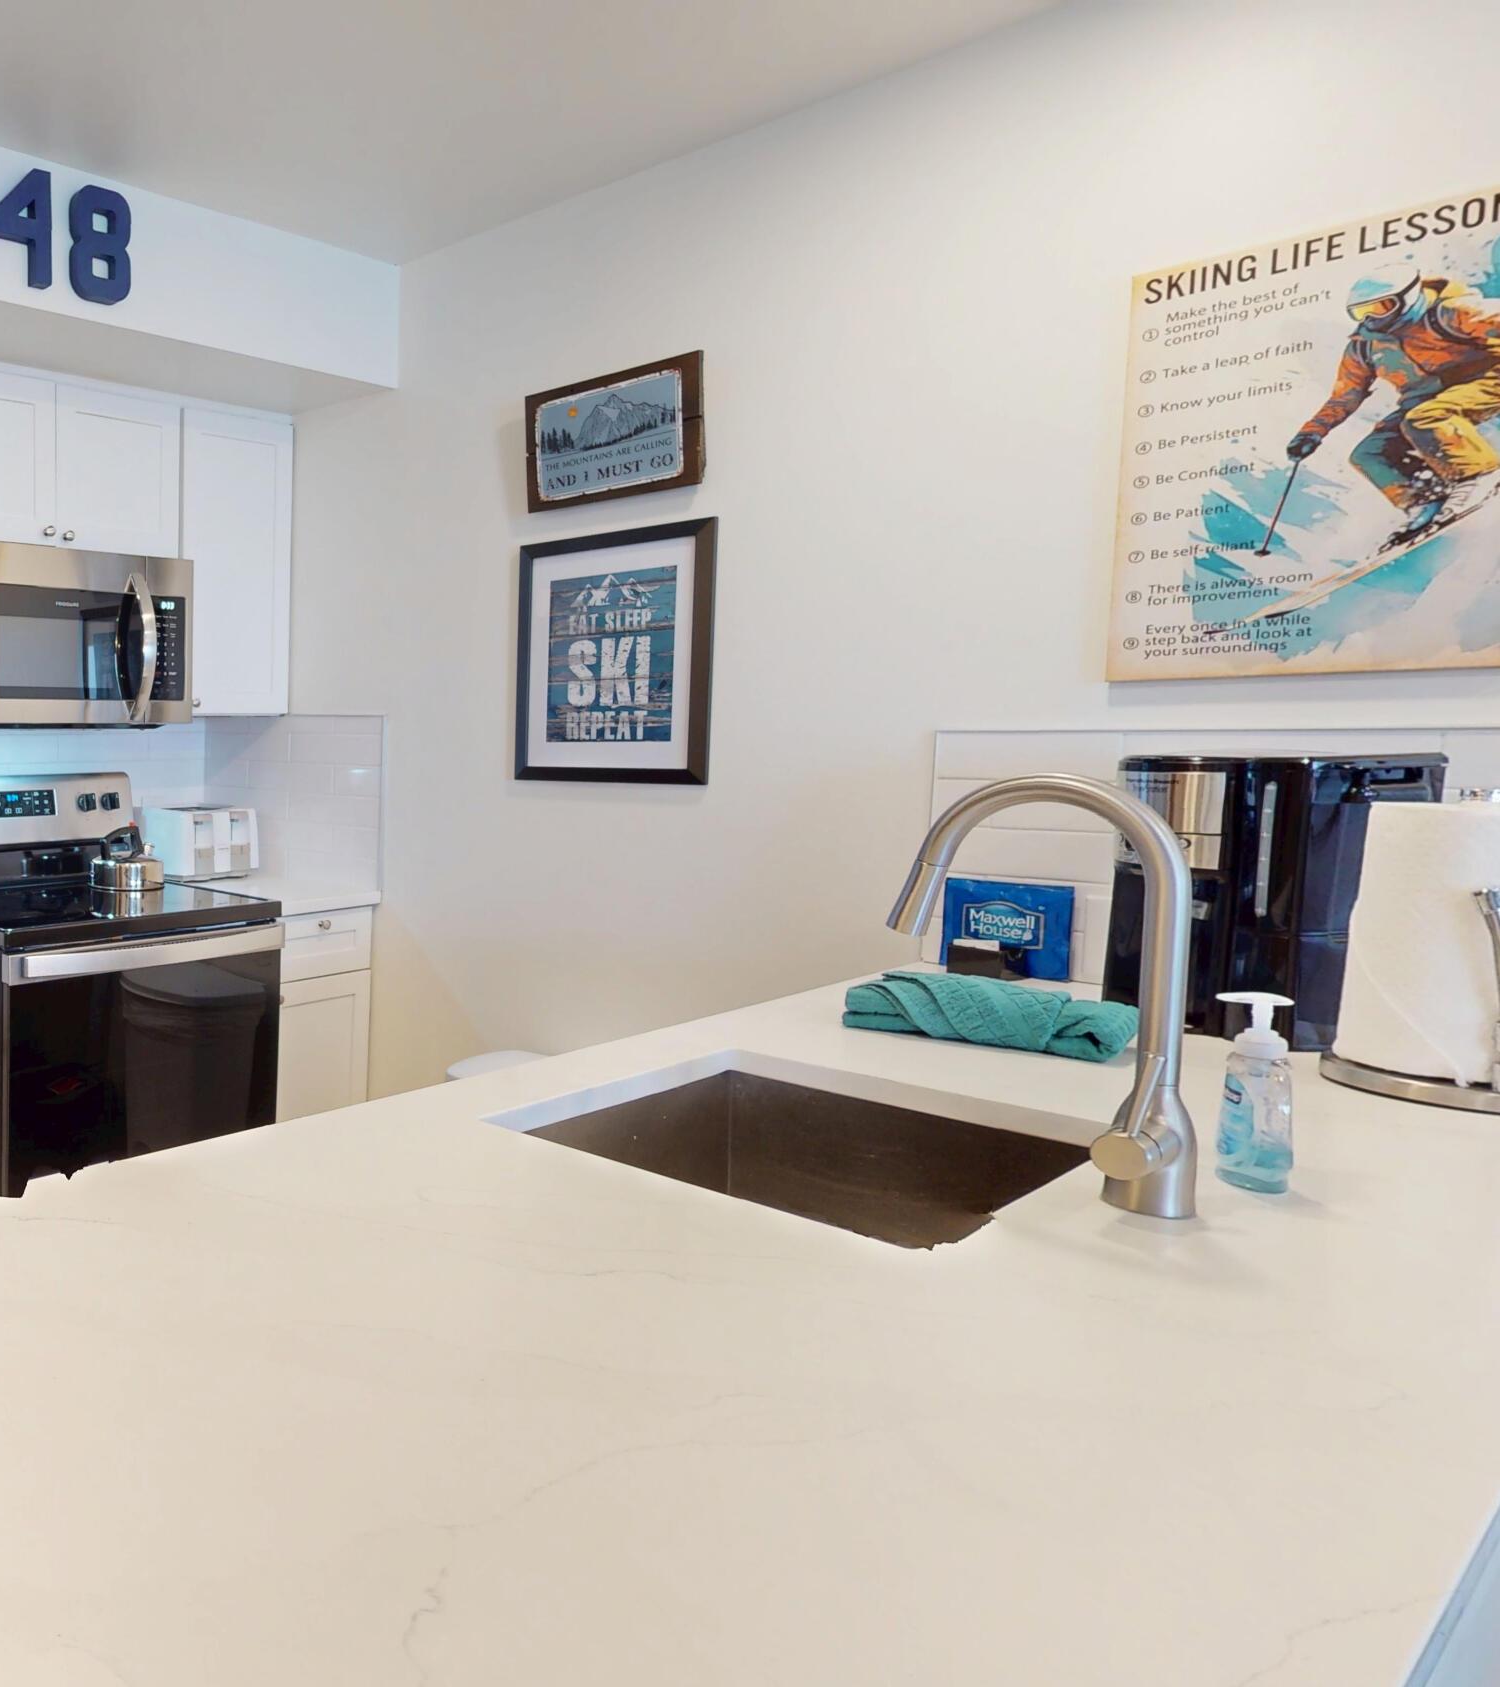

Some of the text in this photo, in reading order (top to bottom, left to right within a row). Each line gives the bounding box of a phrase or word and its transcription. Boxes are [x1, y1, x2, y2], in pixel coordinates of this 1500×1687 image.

[1144, 254, 1257, 305] SKIING
[1270, 231, 1346, 275] LIFE
[1164, 309, 1249, 336] something
[1253, 302, 1285, 318] you
[1289, 288, 1332, 307] can't
[1165, 283, 1300, 324] Make the best of
[1164, 326, 1220, 347] control
[1162, 365, 1198, 379] Take
[1201, 362, 1211, 372] a
[1215, 354, 1250, 370] leap
[1253, 347, 1272, 361] of
[1275, 340, 1313, 357] faith
[1160, 398, 1203, 414] Know
[1207, 389, 1243, 408] your
[1247, 380, 1293, 398] limits
[1158, 438, 1176, 450] Be
[1180, 424, 1258, 446] Persistent
[545, 437, 673, 472] THE MOUNTAINS ARE CALLING
[546, 453, 674, 491] AND I MUST GO
[1155, 474, 1174, 485] Be
[1178, 462, 1255, 481] Confident
[1152, 511, 1171, 522] Be
[1175, 502, 1230, 519] Patient
[1150, 548, 1169, 560] Be
[1173, 539, 1256, 558] self-reliant
[1148, 572, 1314, 595] There is always room
[1147, 594, 1168, 607] for
[1171, 587, 1280, 605] improvement
[568, 608, 652, 635] EAT SLEEP
[1145, 614, 1312, 636] Every once in a while
[1144, 635, 1177, 648] step
[1181, 631, 1218, 644] back
[1221, 628, 1251, 642] and
[1255, 626, 1293, 640] look
[1295, 626, 1313, 637] at
[1143, 642, 1288, 660] your surroundings
[567, 635, 652, 707] SKI
[565, 710, 648, 740] REPEAT
[968, 908, 1036, 930] Maxwell
[970, 920, 1023, 939] House
